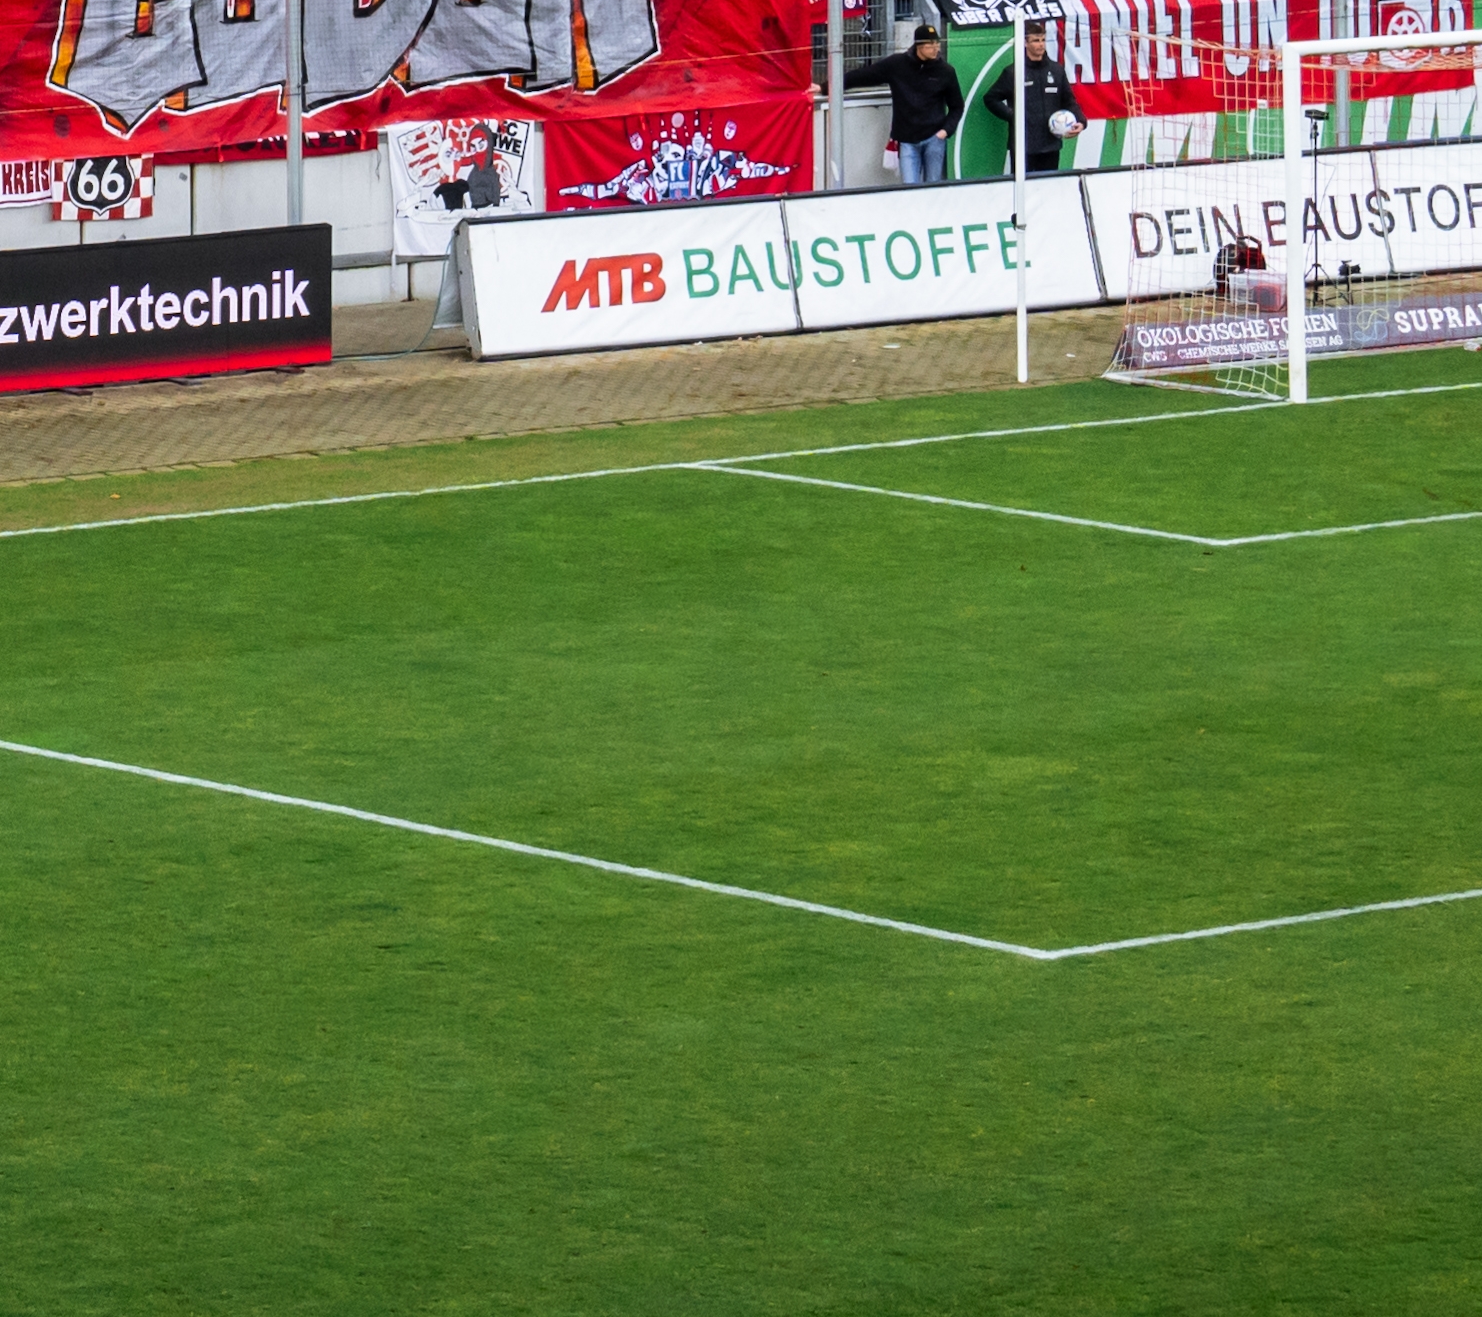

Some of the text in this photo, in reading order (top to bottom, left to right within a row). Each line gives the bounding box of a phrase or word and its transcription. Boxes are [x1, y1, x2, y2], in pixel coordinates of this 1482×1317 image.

[2, 159, 51, 196] KREIS
[76, 158, 125, 202] 66
[1128, 200, 1244, 259] DEIN
[539, 221, 1032, 314] MTB BAUSTOFFE
[1136, 318, 1269, 349] ÖKOLOGISCHE
[1143, 350, 1167, 363] CWS
[1177, 344, 1239, 360] CHEMISCHE
[1240, 341, 1278, 353] WERKE
[1328, 335, 1343, 347] AG
